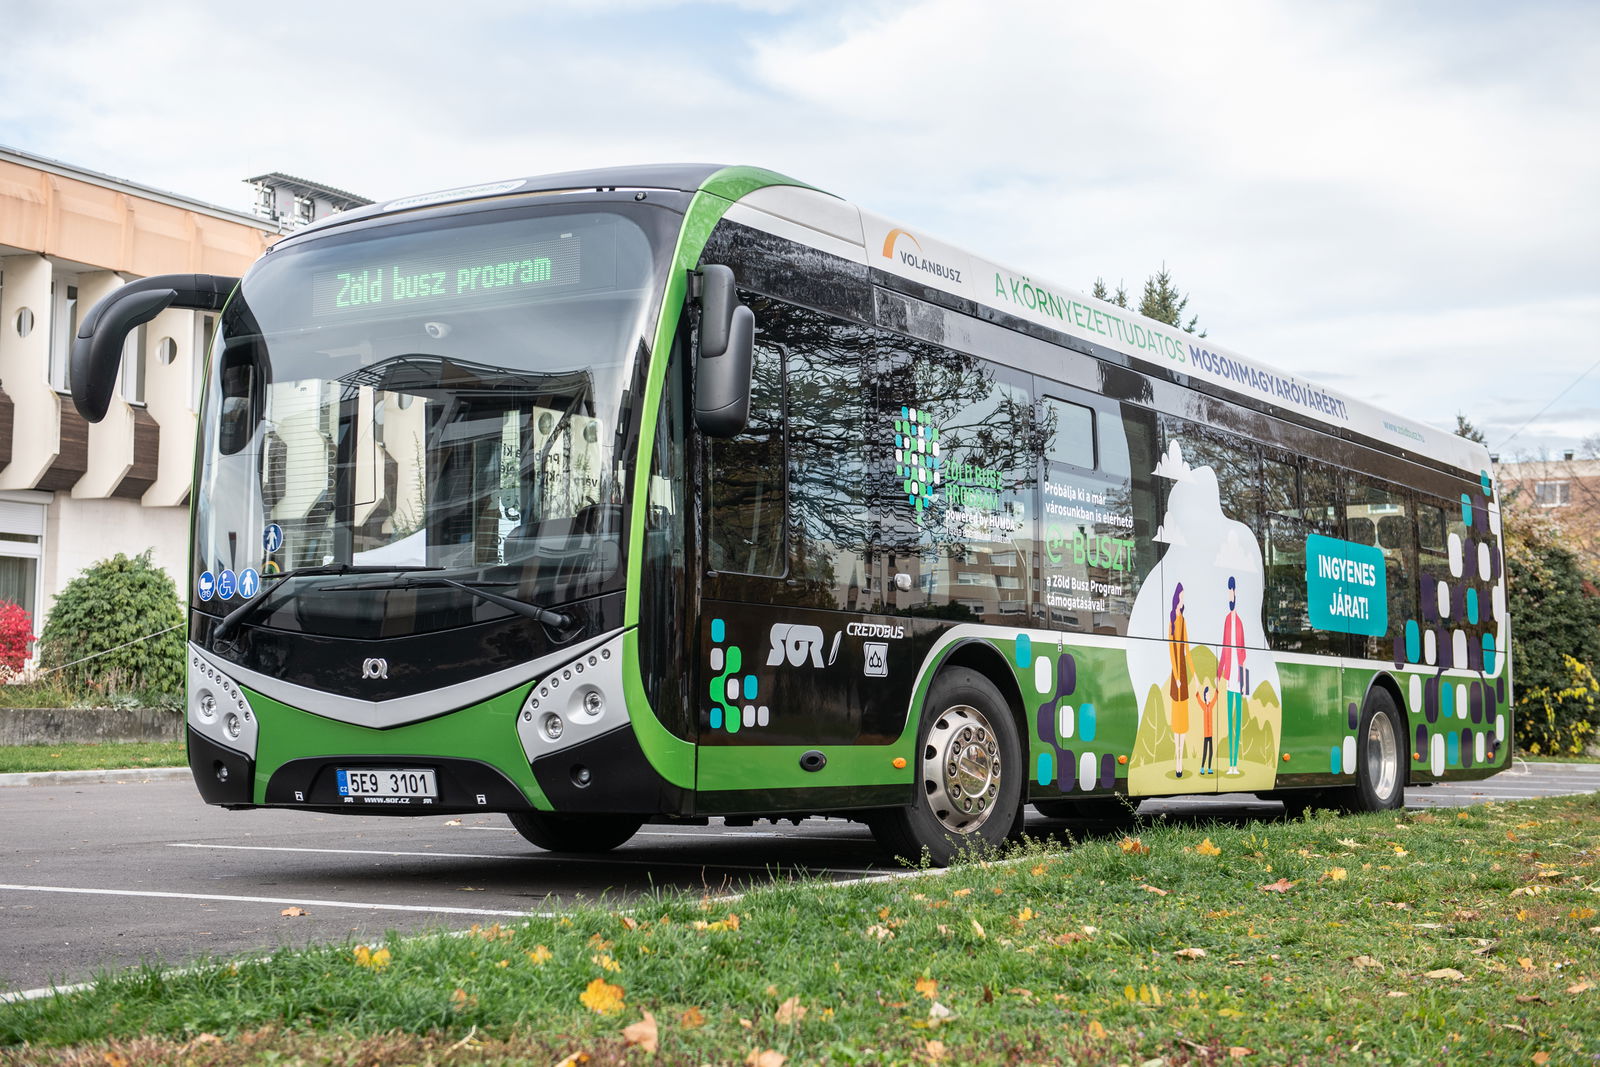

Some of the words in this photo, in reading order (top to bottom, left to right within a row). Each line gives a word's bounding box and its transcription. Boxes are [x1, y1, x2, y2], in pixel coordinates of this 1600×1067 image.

[900, 250, 962, 283] VOLÁNBUSZ
[336, 269, 382, 307] Zöld
[393, 266, 446, 300] busz
[457, 257, 551, 294] program
[995, 272, 1008, 301] A
[1009, 276, 1187, 363] KÖRNYEZETTUDATOS
[1189, 344, 1349, 420] MOSONMAGYARÓVÁRÉRT!
[944, 456, 972, 483] ZÖLD
[975, 466, 1003, 490] BUSZ
[945, 483, 998, 510] PROGRAM
[1044, 482, 1076, 501] Próbálja
[1077, 487, 1085, 502] ki
[1086, 493, 1091, 502] a
[1091, 492, 1107, 505] már
[946, 509, 978, 528] powered
[1045, 500, 1095, 521] városunkban
[1095, 509, 1102, 523] is
[1103, 511, 1133, 528] elérhető
[1318, 554, 1376, 587] INGYENES
[1046, 576, 1051, 587] a
[1052, 574, 1070, 589] Zöld
[1071, 577, 1089, 592] Busz
[1090, 580, 1122, 597] Program
[1047, 592, 1105, 612] támogatásával!
[1330, 586, 1369, 620] JÁRAT!
[846, 622, 904, 639] CREDOBUS
[350, 773, 378, 793] 5E9
[390, 773, 428, 794] 3101
